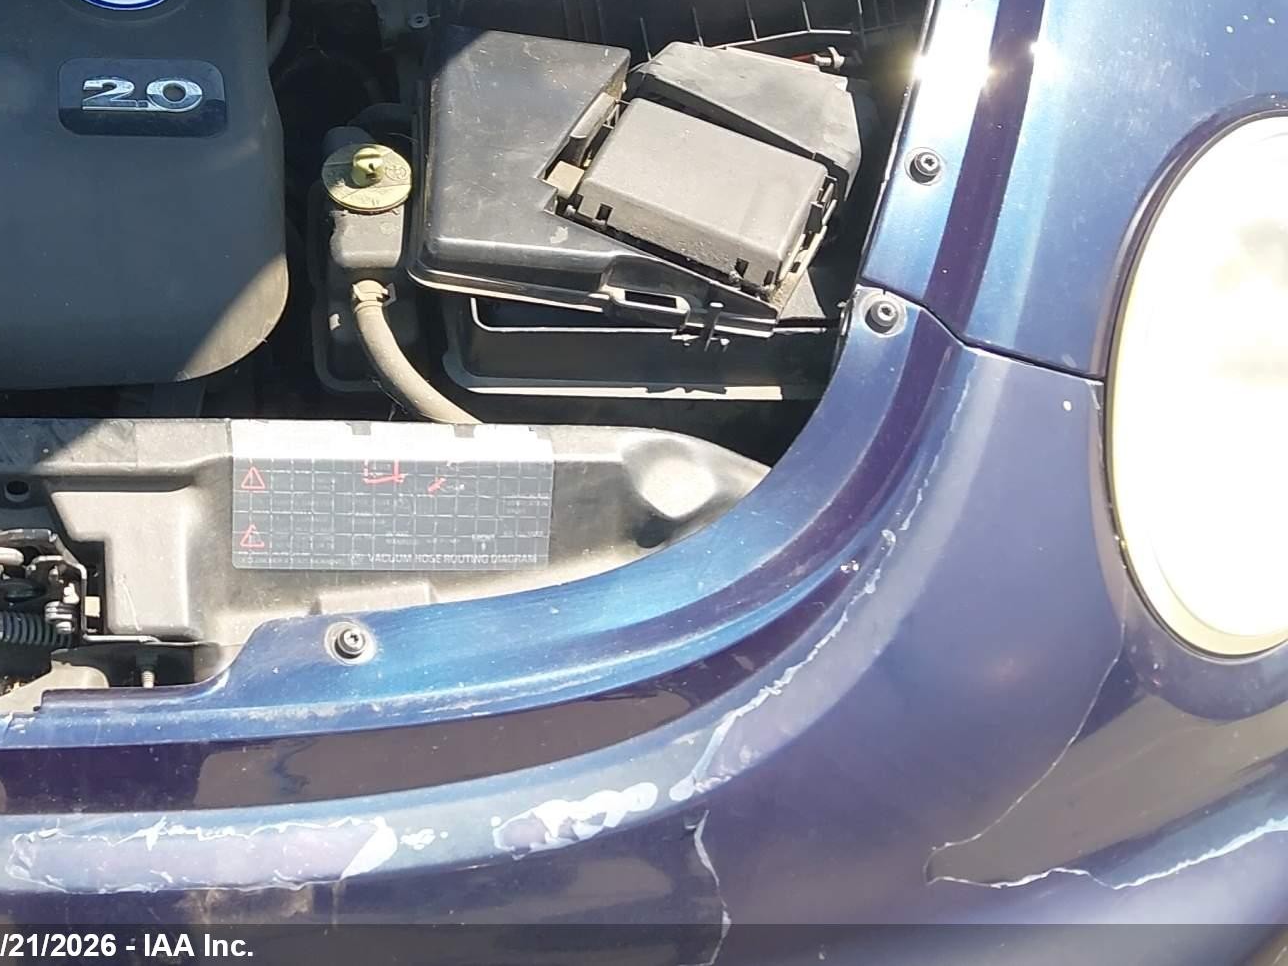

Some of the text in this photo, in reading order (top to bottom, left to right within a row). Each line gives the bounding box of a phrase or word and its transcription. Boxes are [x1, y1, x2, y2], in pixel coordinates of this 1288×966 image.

[82, 79, 203, 113] 2.0
[367, 553, 537, 564] VACUUM HOSE ROUTING DIAGRAM
